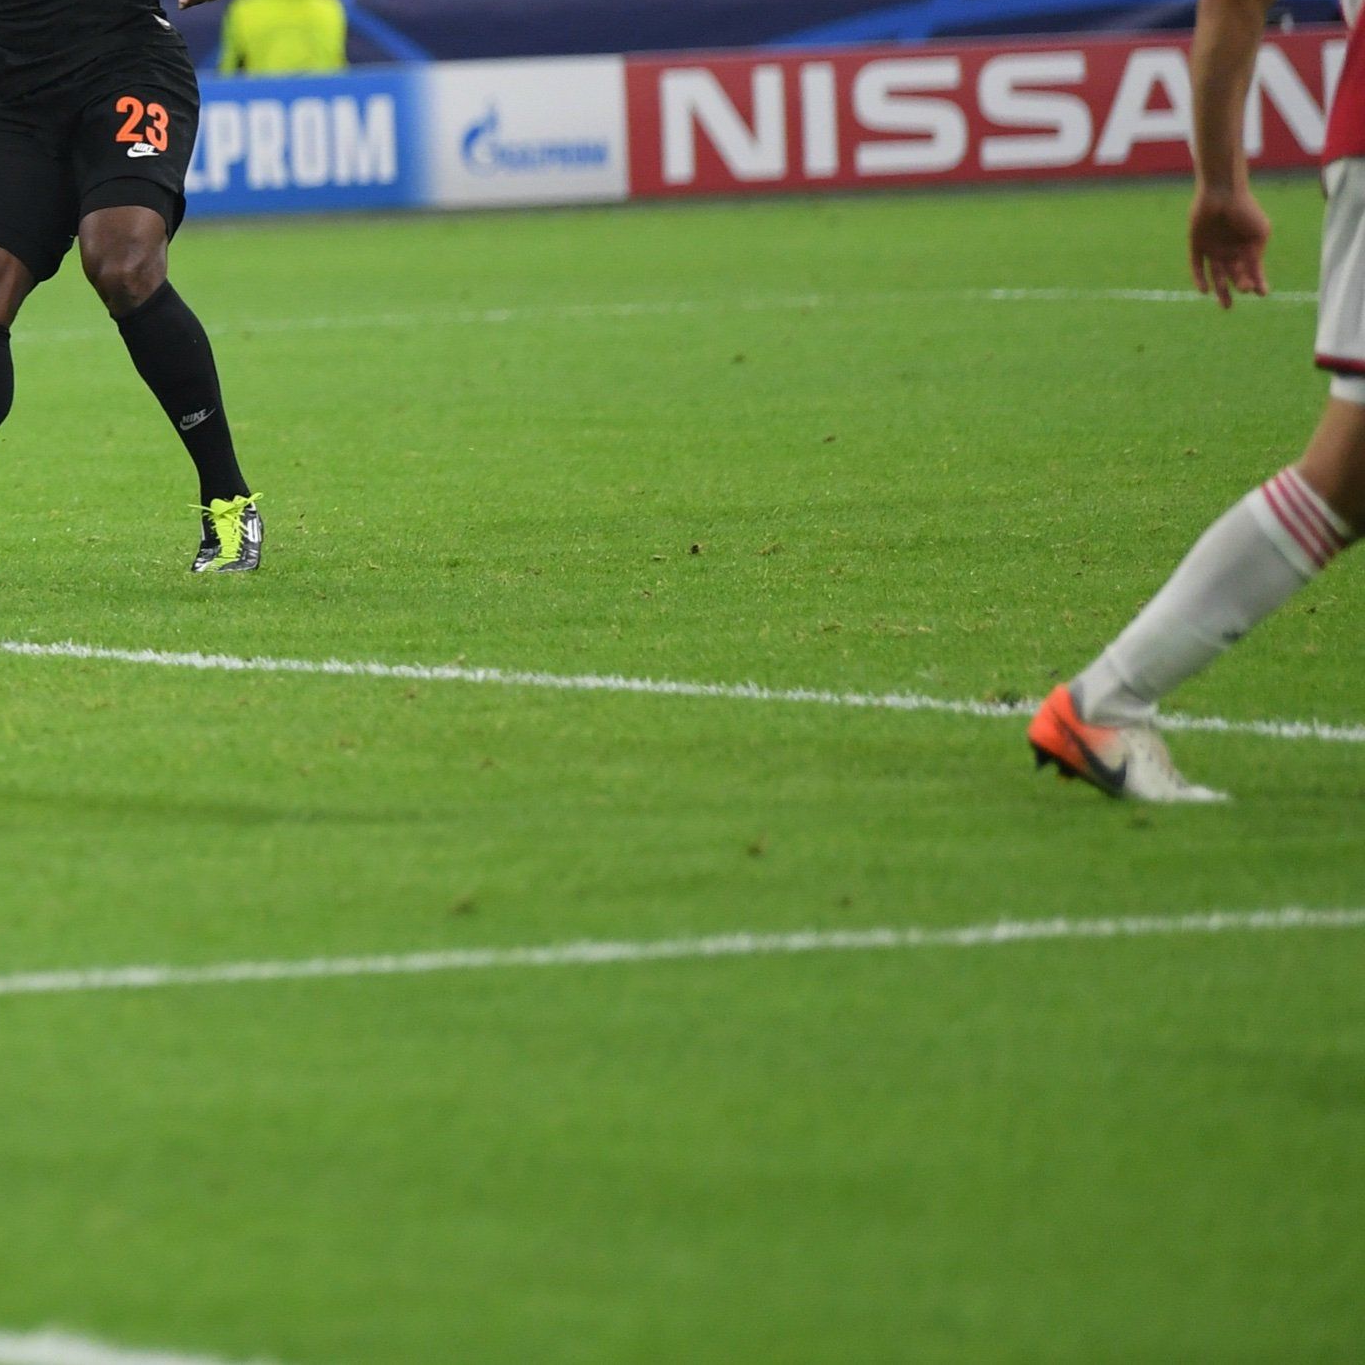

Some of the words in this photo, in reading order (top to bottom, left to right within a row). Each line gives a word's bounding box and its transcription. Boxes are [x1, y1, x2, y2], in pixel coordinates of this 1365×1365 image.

[115, 96, 169, 152] 23
[184, 92, 398, 193] PROM
[658, 37, 1349, 184] NISSAN
